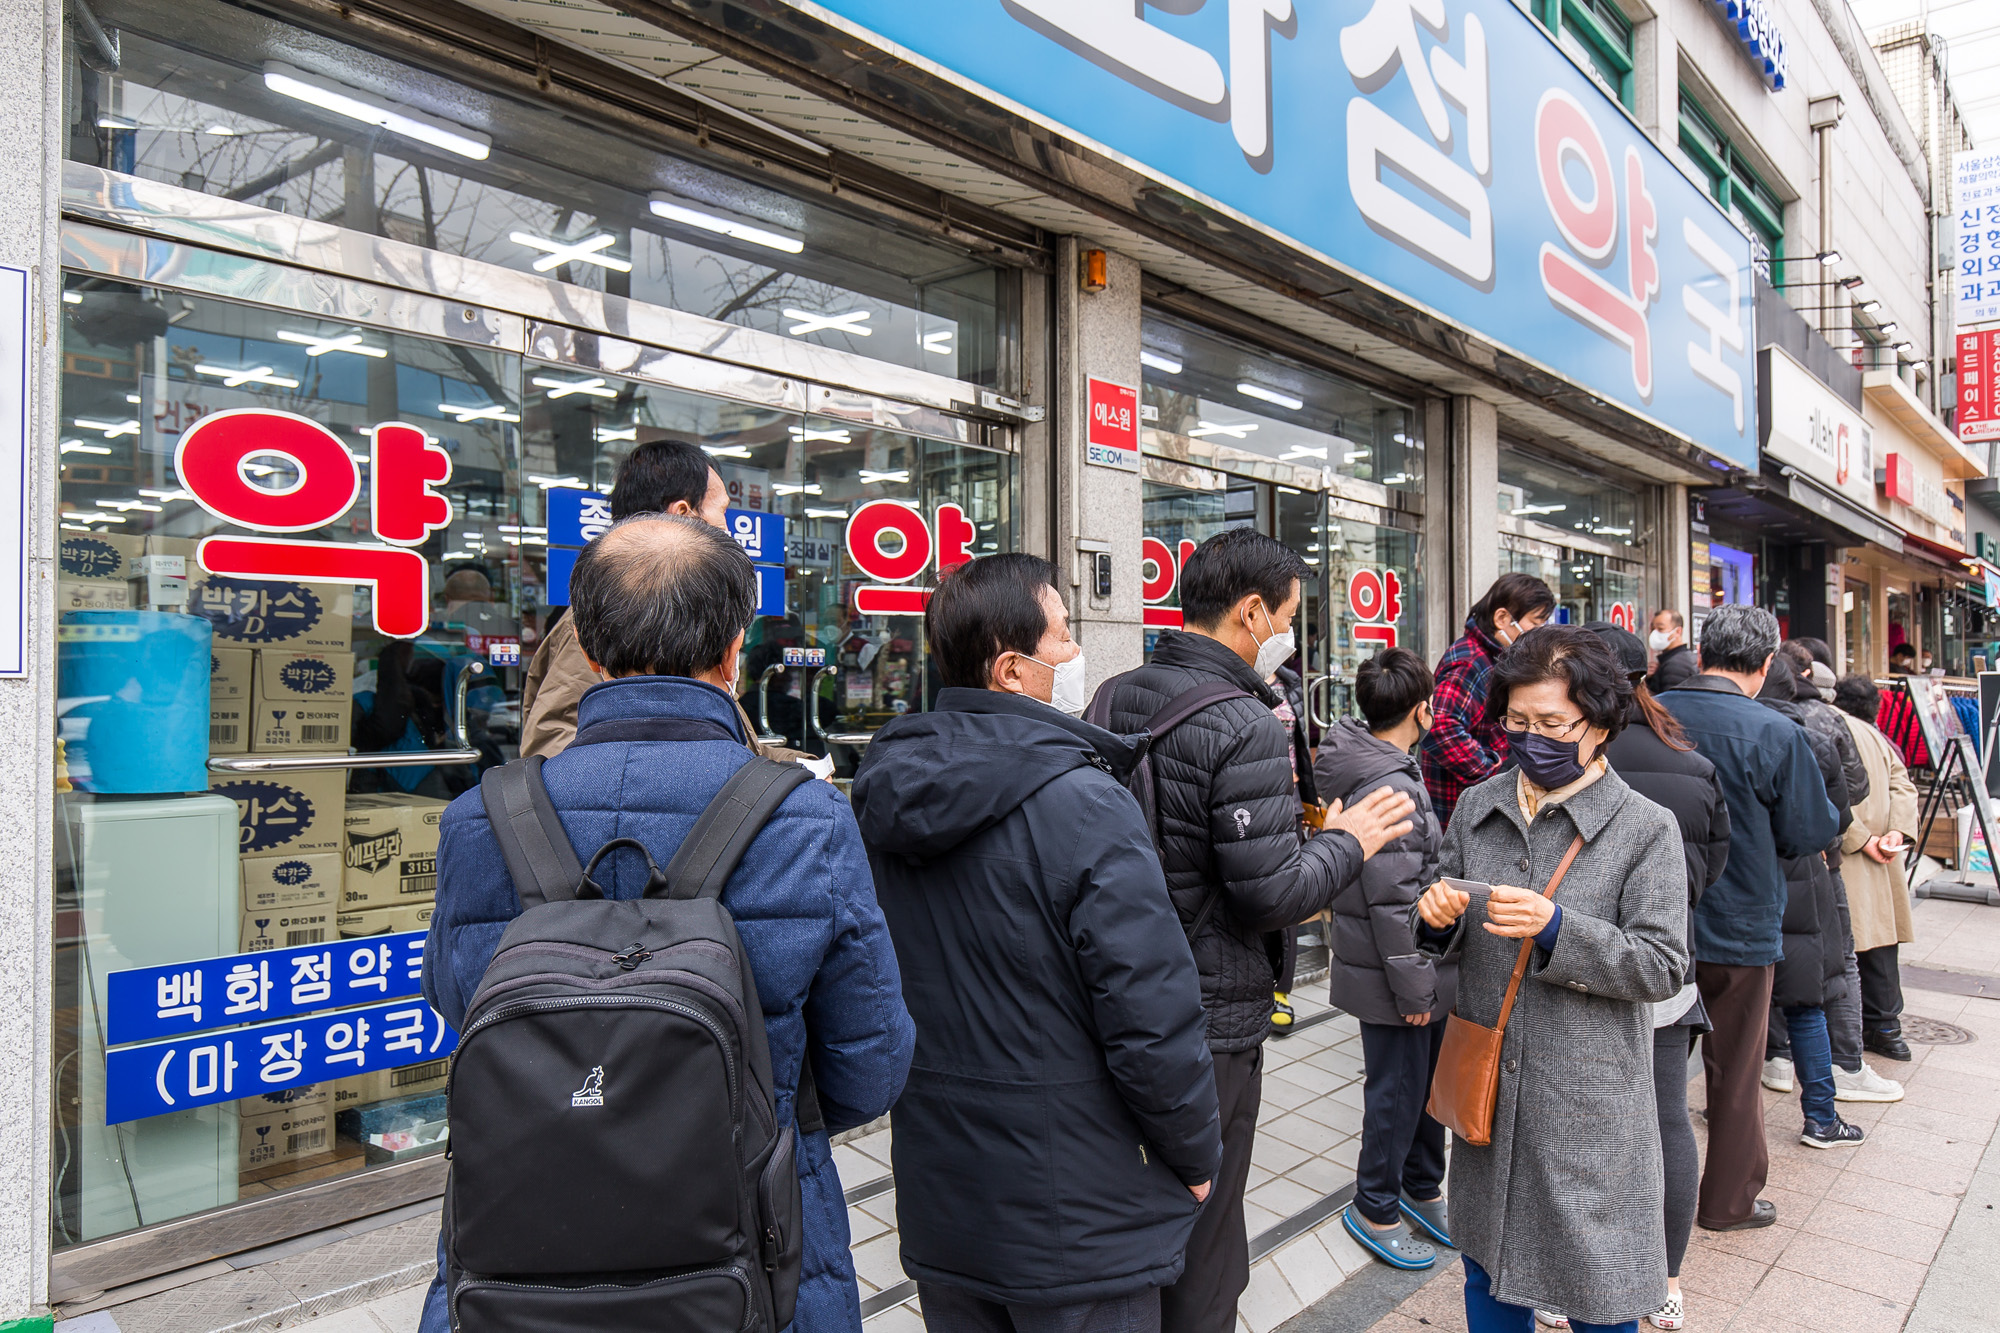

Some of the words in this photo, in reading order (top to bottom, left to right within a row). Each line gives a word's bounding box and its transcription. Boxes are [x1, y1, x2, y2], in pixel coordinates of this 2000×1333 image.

[1962, 336, 1979, 420] 레드페이스
[1095, 402, 1131, 432] 에스원
[1089, 447, 1123, 465] SECOM
[175, 408, 455, 640] 약
[61, 546, 114, 565] 박카스
[790, 539, 830, 562] 조제실
[81, 563, 94, 573] D
[201, 585, 307, 619] 박카스
[1348, 567, 1402, 649] 약
[242, 616, 265, 635] D
[287, 668, 330, 682] 박카스
[302, 681, 314, 690] D
[239, 797, 298, 826] 카스
[1236, 820, 1246, 839] NEPA
[345, 832, 402, 868] 에프킬라
[277, 868, 308, 877] 박카스
